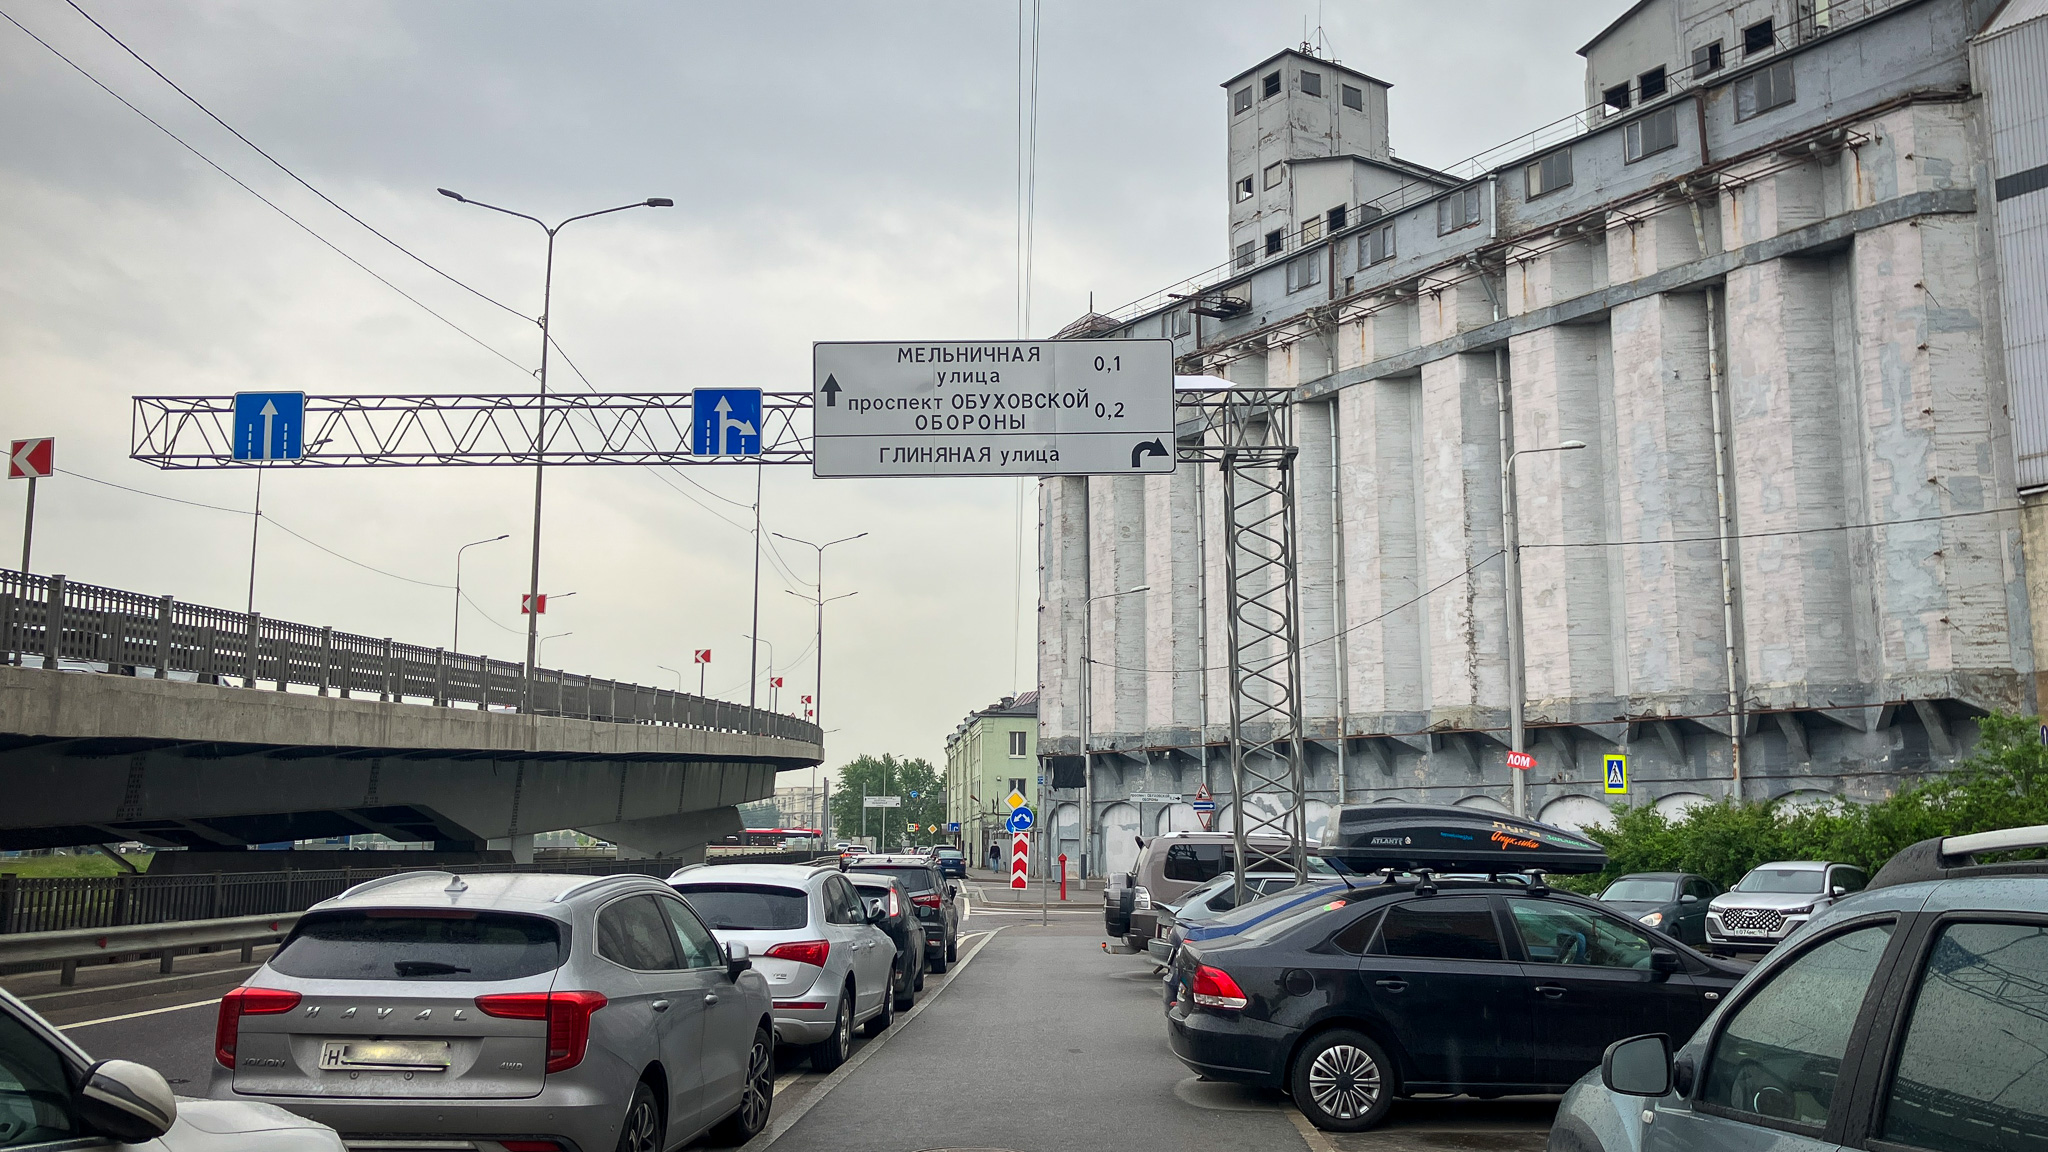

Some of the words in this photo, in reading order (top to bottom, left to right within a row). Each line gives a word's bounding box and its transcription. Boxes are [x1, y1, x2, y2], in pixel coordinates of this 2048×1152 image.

[897, 346, 1041, 363] МЕЛЬНИЧНАЯ
[1093, 356, 1122, 372] 0,1
[936, 371, 1001, 387] улица
[848, 396, 943, 414] проспект
[951, 388, 1089, 409] ОБУХОВСКОЙ
[1094, 402, 1125, 420] 0,2
[915, 414, 1026, 431] ОБОРОНЫ
[879, 446, 992, 464] ГЛИНЯНАЯ
[1000, 449, 1060, 466] улица
[1506, 753, 1531, 768] ЛОМ
[1492, 820, 1542, 838] Луга
[304, 1006, 468, 1021] HAVAL
[242, 1057, 287, 1069] JOLION
[499, 1061, 524, 1071] 4WD
